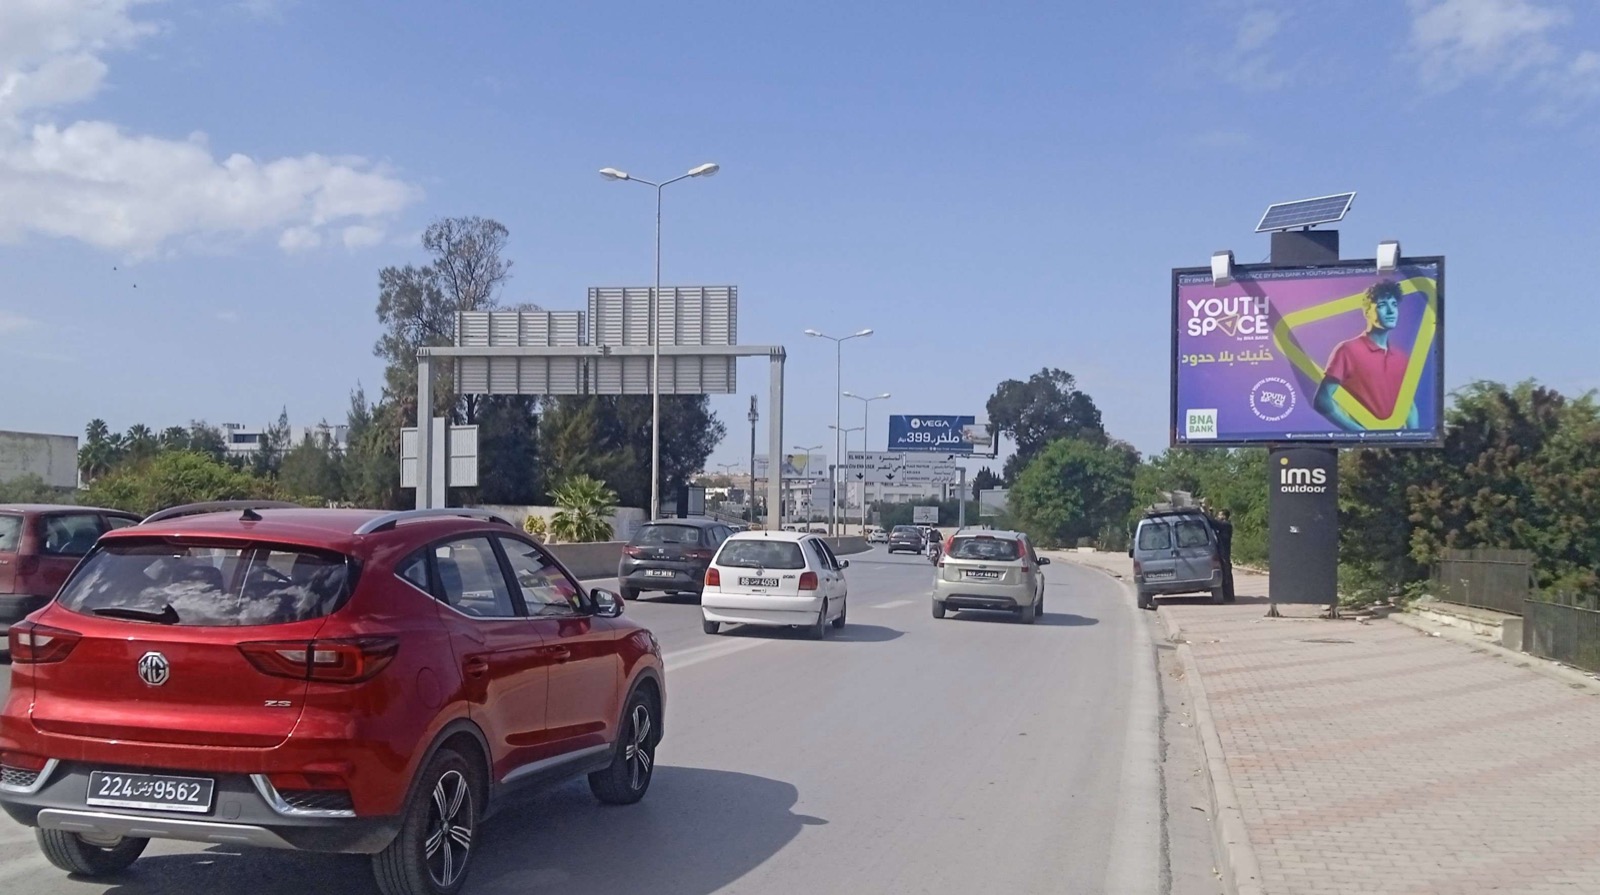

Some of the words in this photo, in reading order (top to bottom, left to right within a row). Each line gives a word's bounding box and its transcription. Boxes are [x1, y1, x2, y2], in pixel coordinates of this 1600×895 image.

[1305, 268, 1326, 276] YOUTH
[1187, 296, 1269, 317] YOUTH
[1181, 354, 1215, 366] حدود
[1218, 351, 1234, 366] بلا
[921, 419, 950, 427] VEGA
[1189, 414, 1214, 425] BNA
[1189, 425, 1214, 433] BANK
[1280, 457, 1327, 484] ims
[1281, 485, 1327, 493] outdoor
[264, 700, 292, 708] ZS
[99, 775, 132, 797] 224
[133, 781, 154, 797] تونس
[153, 780, 201, 802] 9562
